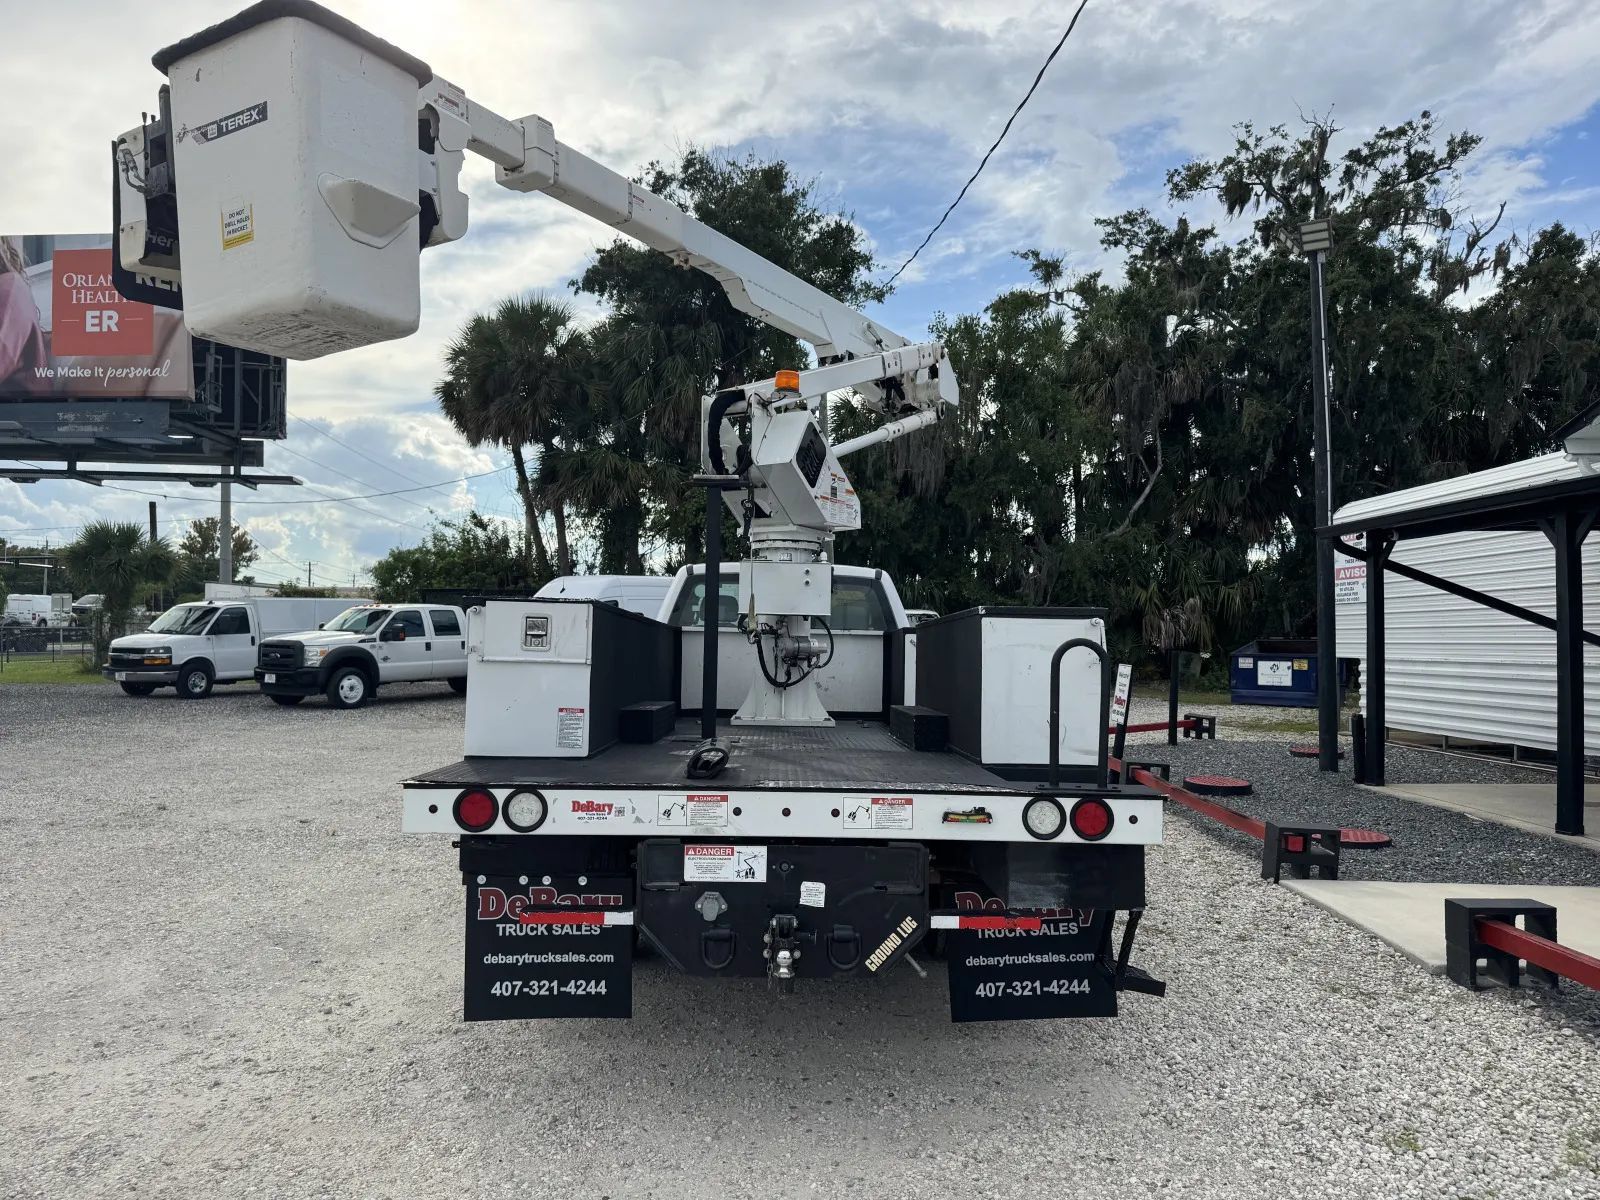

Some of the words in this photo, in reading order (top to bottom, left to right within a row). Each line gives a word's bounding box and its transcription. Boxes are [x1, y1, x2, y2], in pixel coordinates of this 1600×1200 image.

[220, 108, 260, 133] TEREX
[236, 208, 245, 216] NOT
[85, 310, 119, 333] ER
[34, 367, 55, 379] We
[57, 366, 92, 378] Make
[94, 366, 104, 378] It
[104, 360, 171, 388] personal
[1339, 567, 1366, 578] AVISO
[571, 799, 614, 815] DeBary
[696, 848, 732, 856] DANGER
[496, 923, 549, 936] TRUCK
[552, 922, 601, 936] SALES
[864, 932, 902, 972] GROUND
[896, 915, 918, 939] LUG
[483, 952, 615, 966] debarytrucksales.com
[965, 952, 1096, 967] debarytrucksales.com
[490, 980, 608, 997] 407-321-4244
[975, 979, 1092, 998] 407-321-4244
